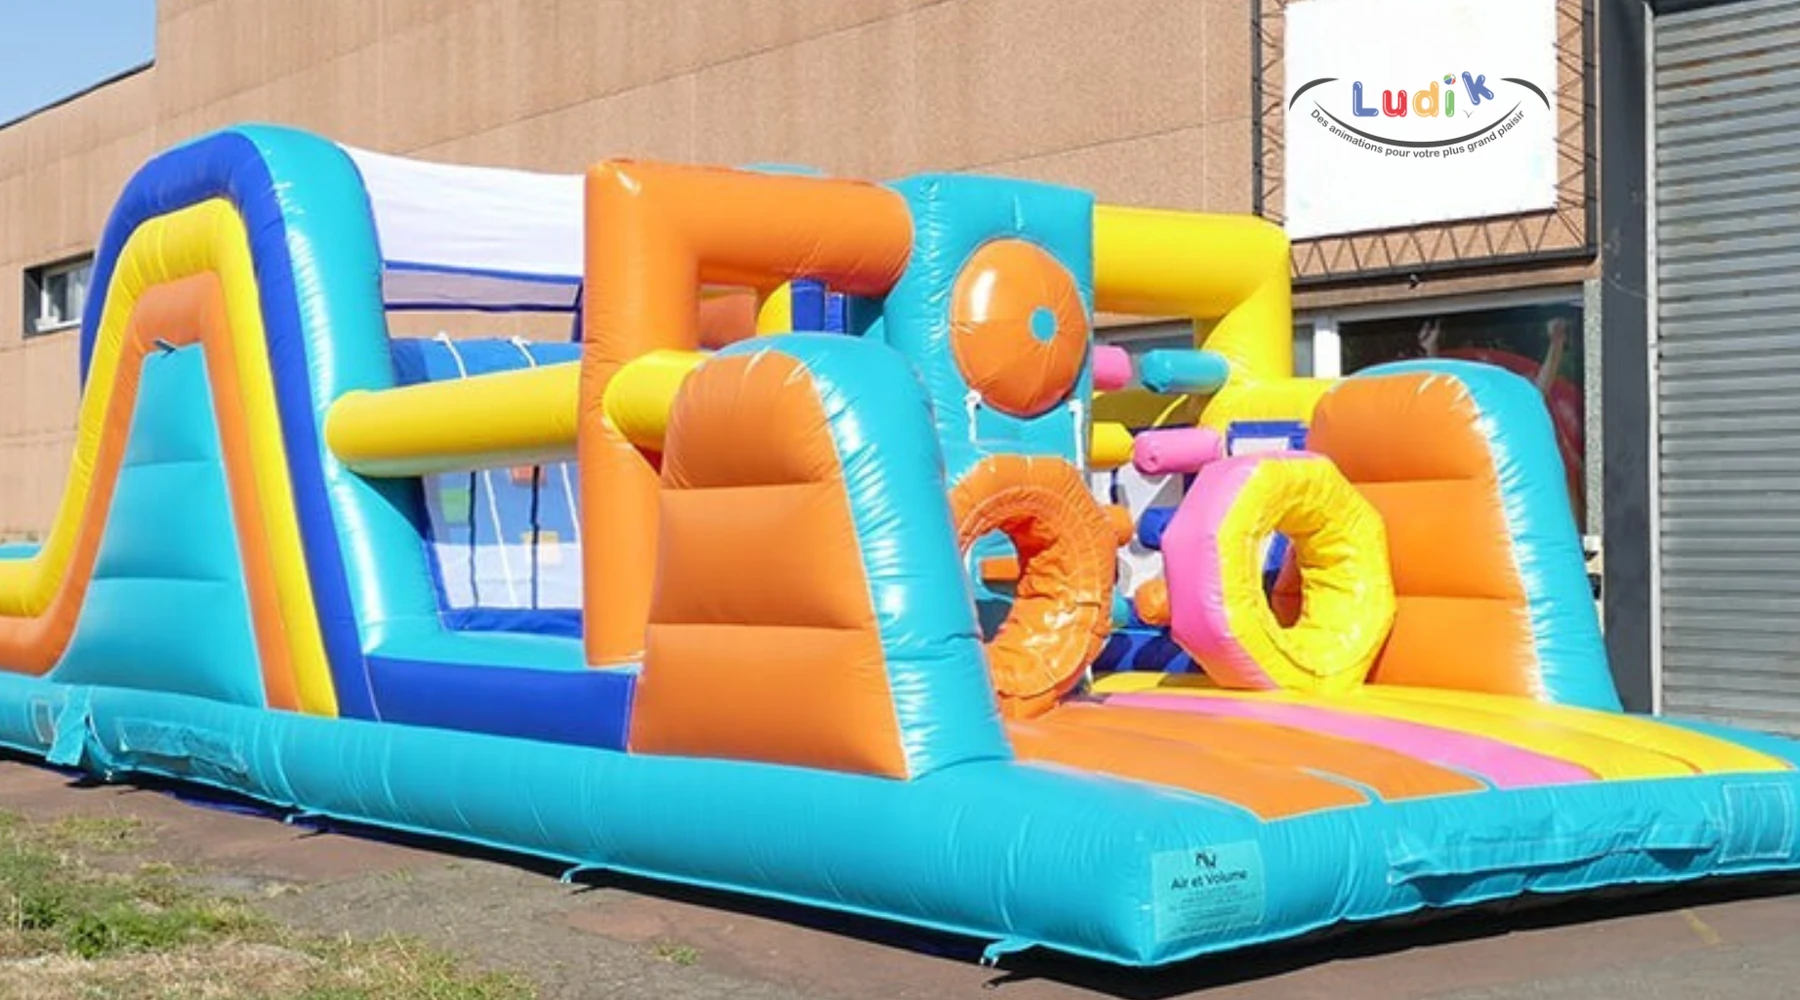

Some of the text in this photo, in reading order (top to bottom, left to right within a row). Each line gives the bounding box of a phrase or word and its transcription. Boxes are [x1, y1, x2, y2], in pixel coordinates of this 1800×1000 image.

[1171, 869, 1247, 890] Air et Volume
